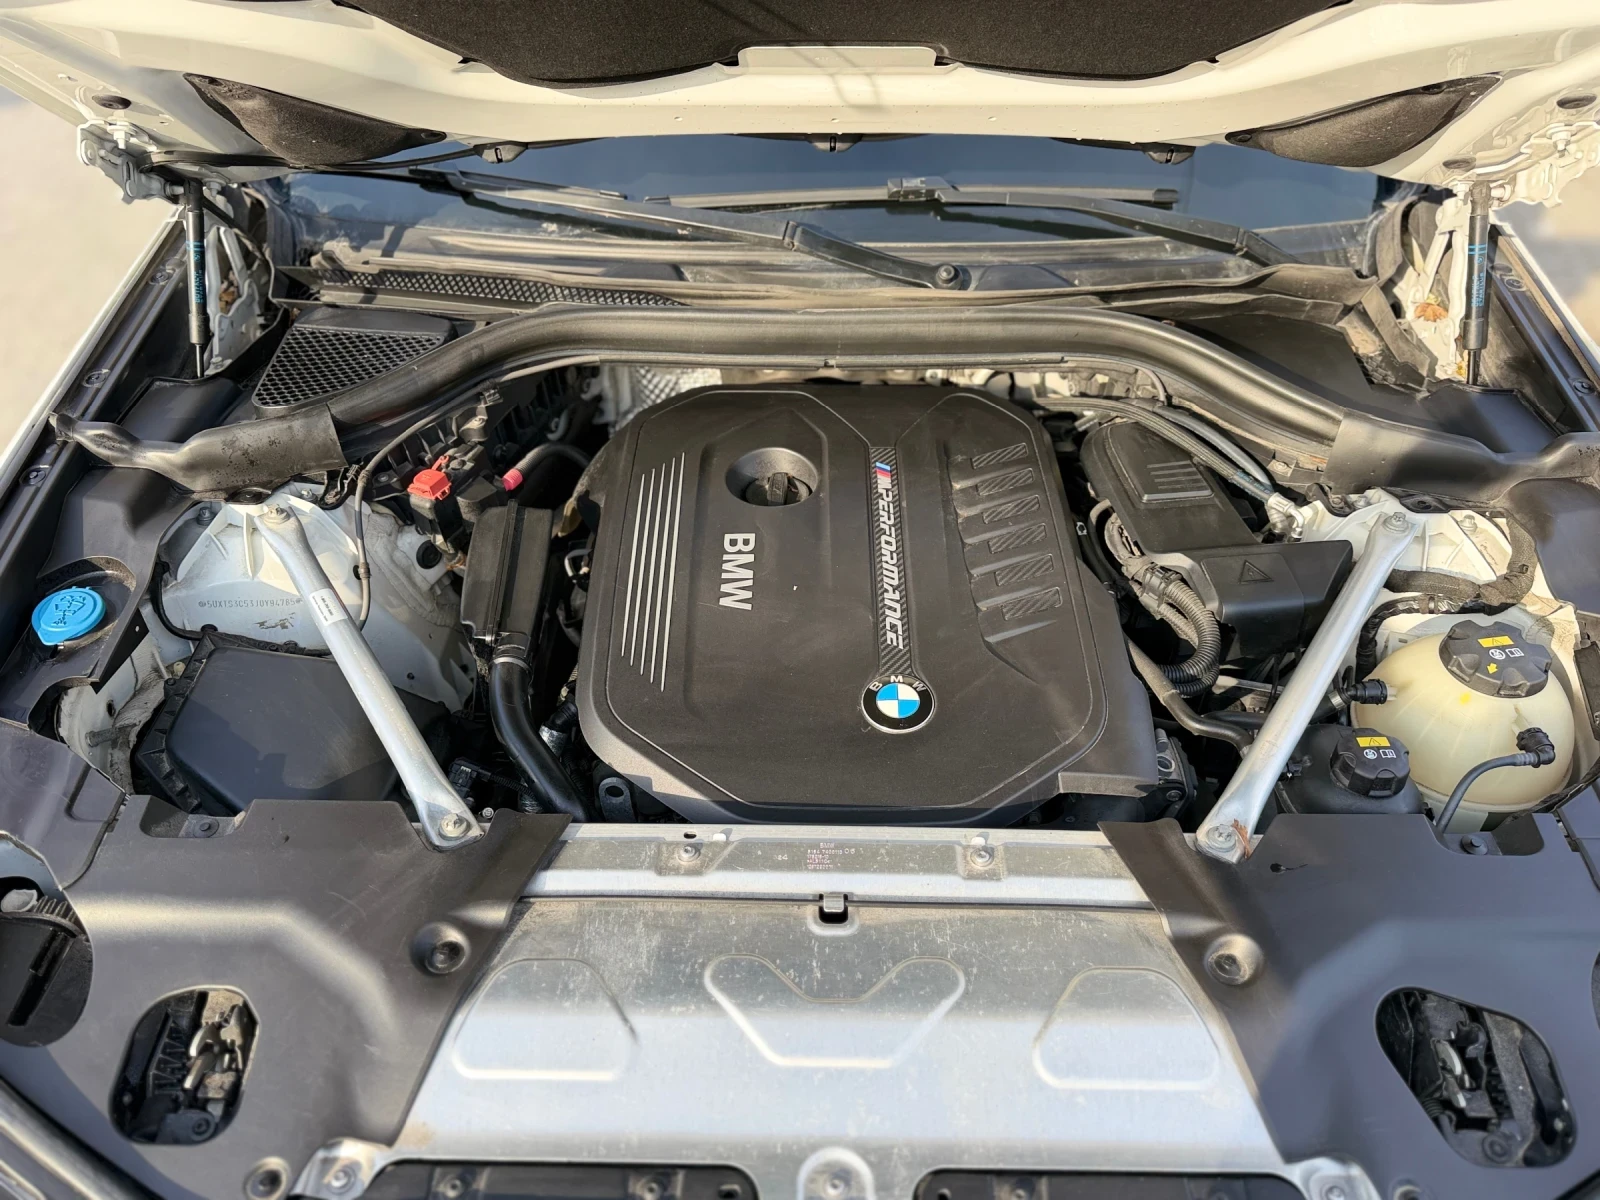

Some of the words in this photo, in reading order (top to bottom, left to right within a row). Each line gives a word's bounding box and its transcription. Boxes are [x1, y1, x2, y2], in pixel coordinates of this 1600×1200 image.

[719, 532, 756, 611] BMW
[877, 488, 904, 650] PERFORMANCE
[868, 675, 927, 692] BMW
